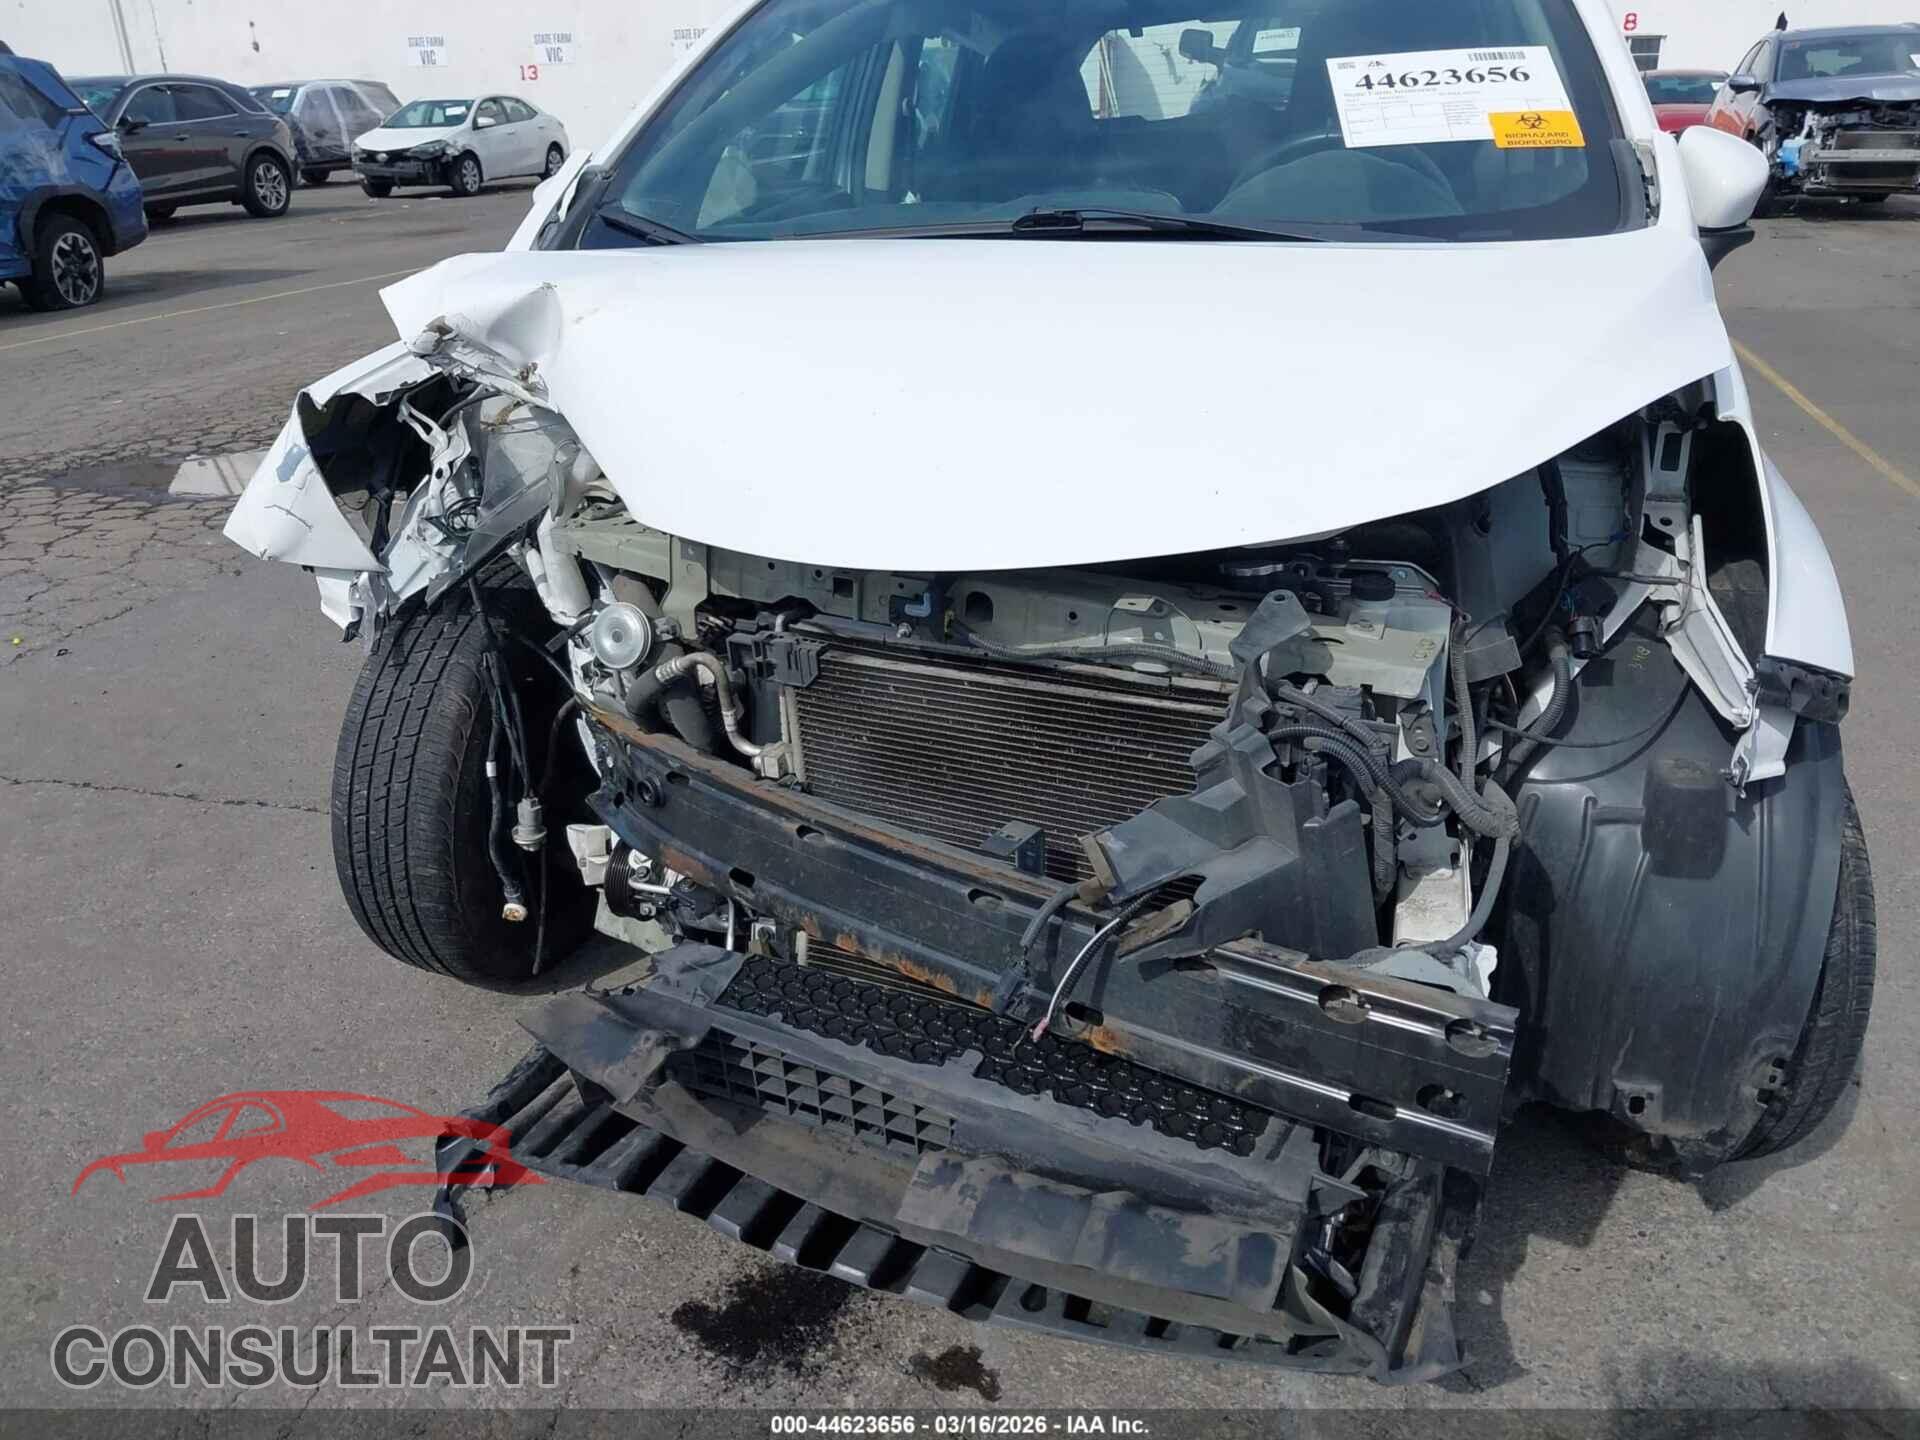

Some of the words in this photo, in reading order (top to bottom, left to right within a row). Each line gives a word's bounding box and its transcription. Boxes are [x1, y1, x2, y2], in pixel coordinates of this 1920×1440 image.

[1623, 12, 1638, 31] 8
[408, 36, 425, 48] STATE
[426, 35, 444, 47] FARM
[533, 33, 552, 45] STATE
[553, 32, 572, 44] FARM
[419, 49, 437, 65] VIC
[545, 47, 563, 62] VIC
[519, 64, 538, 81] 13
[1355, 65, 1531, 91] 44623656
[1504, 131, 1569, 140] BIOHAZARD
[1506, 138, 1573, 146] BIOPELIGRO
